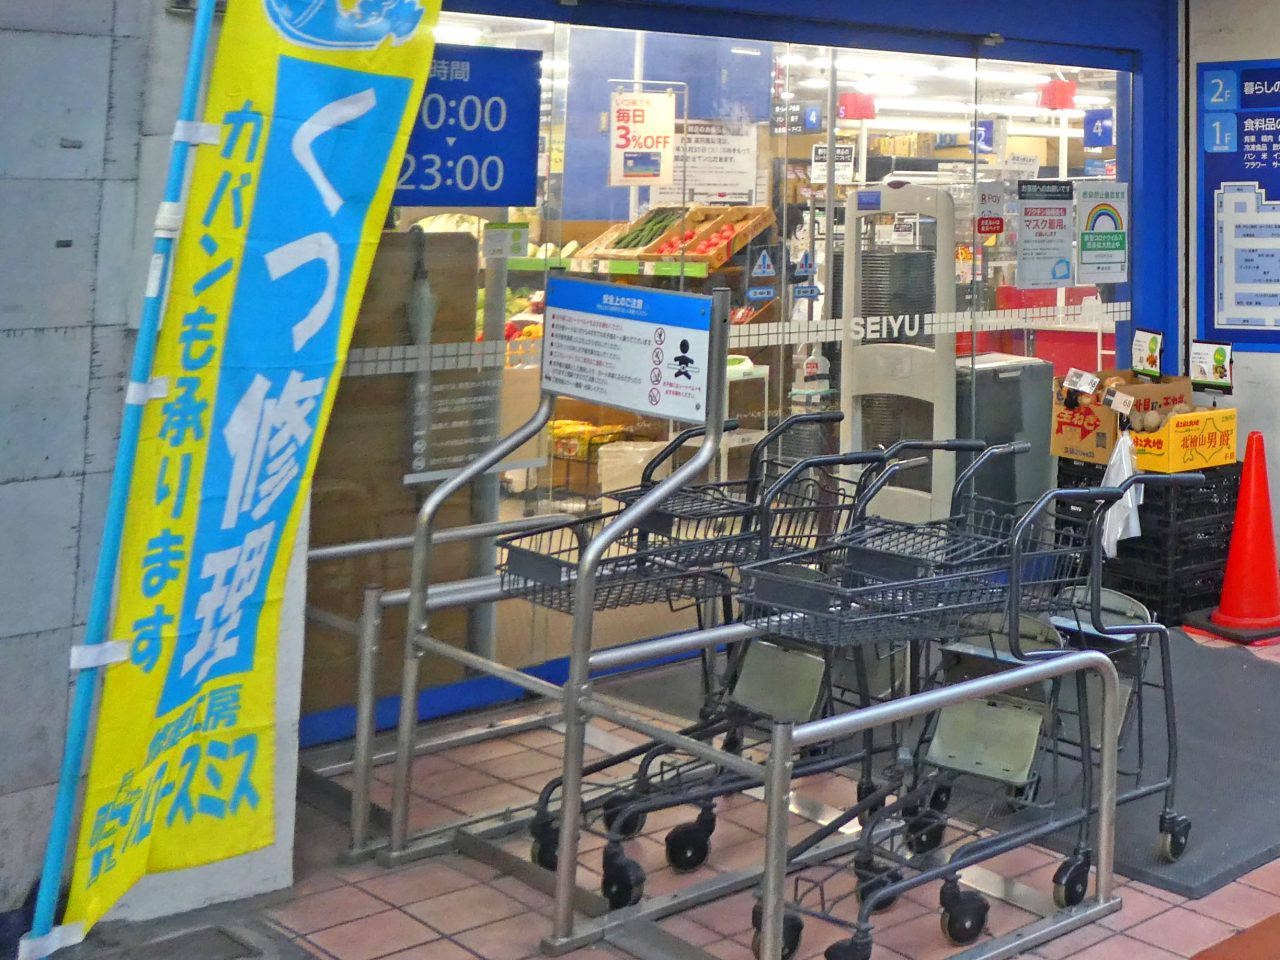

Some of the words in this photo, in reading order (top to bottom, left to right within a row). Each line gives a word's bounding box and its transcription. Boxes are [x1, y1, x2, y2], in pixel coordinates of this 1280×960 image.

[616, 108, 645, 124] 毎日
[809, 111, 817, 124] 4
[1093, 120, 1103, 137] 4
[615, 125, 671, 150] 3%OFF
[397, 153, 505, 191] 23:00
[850, 314, 921, 340] SEIYU
[129, 99, 263, 674] カバンも承ります
[179, 87, 377, 687] くつ修理
